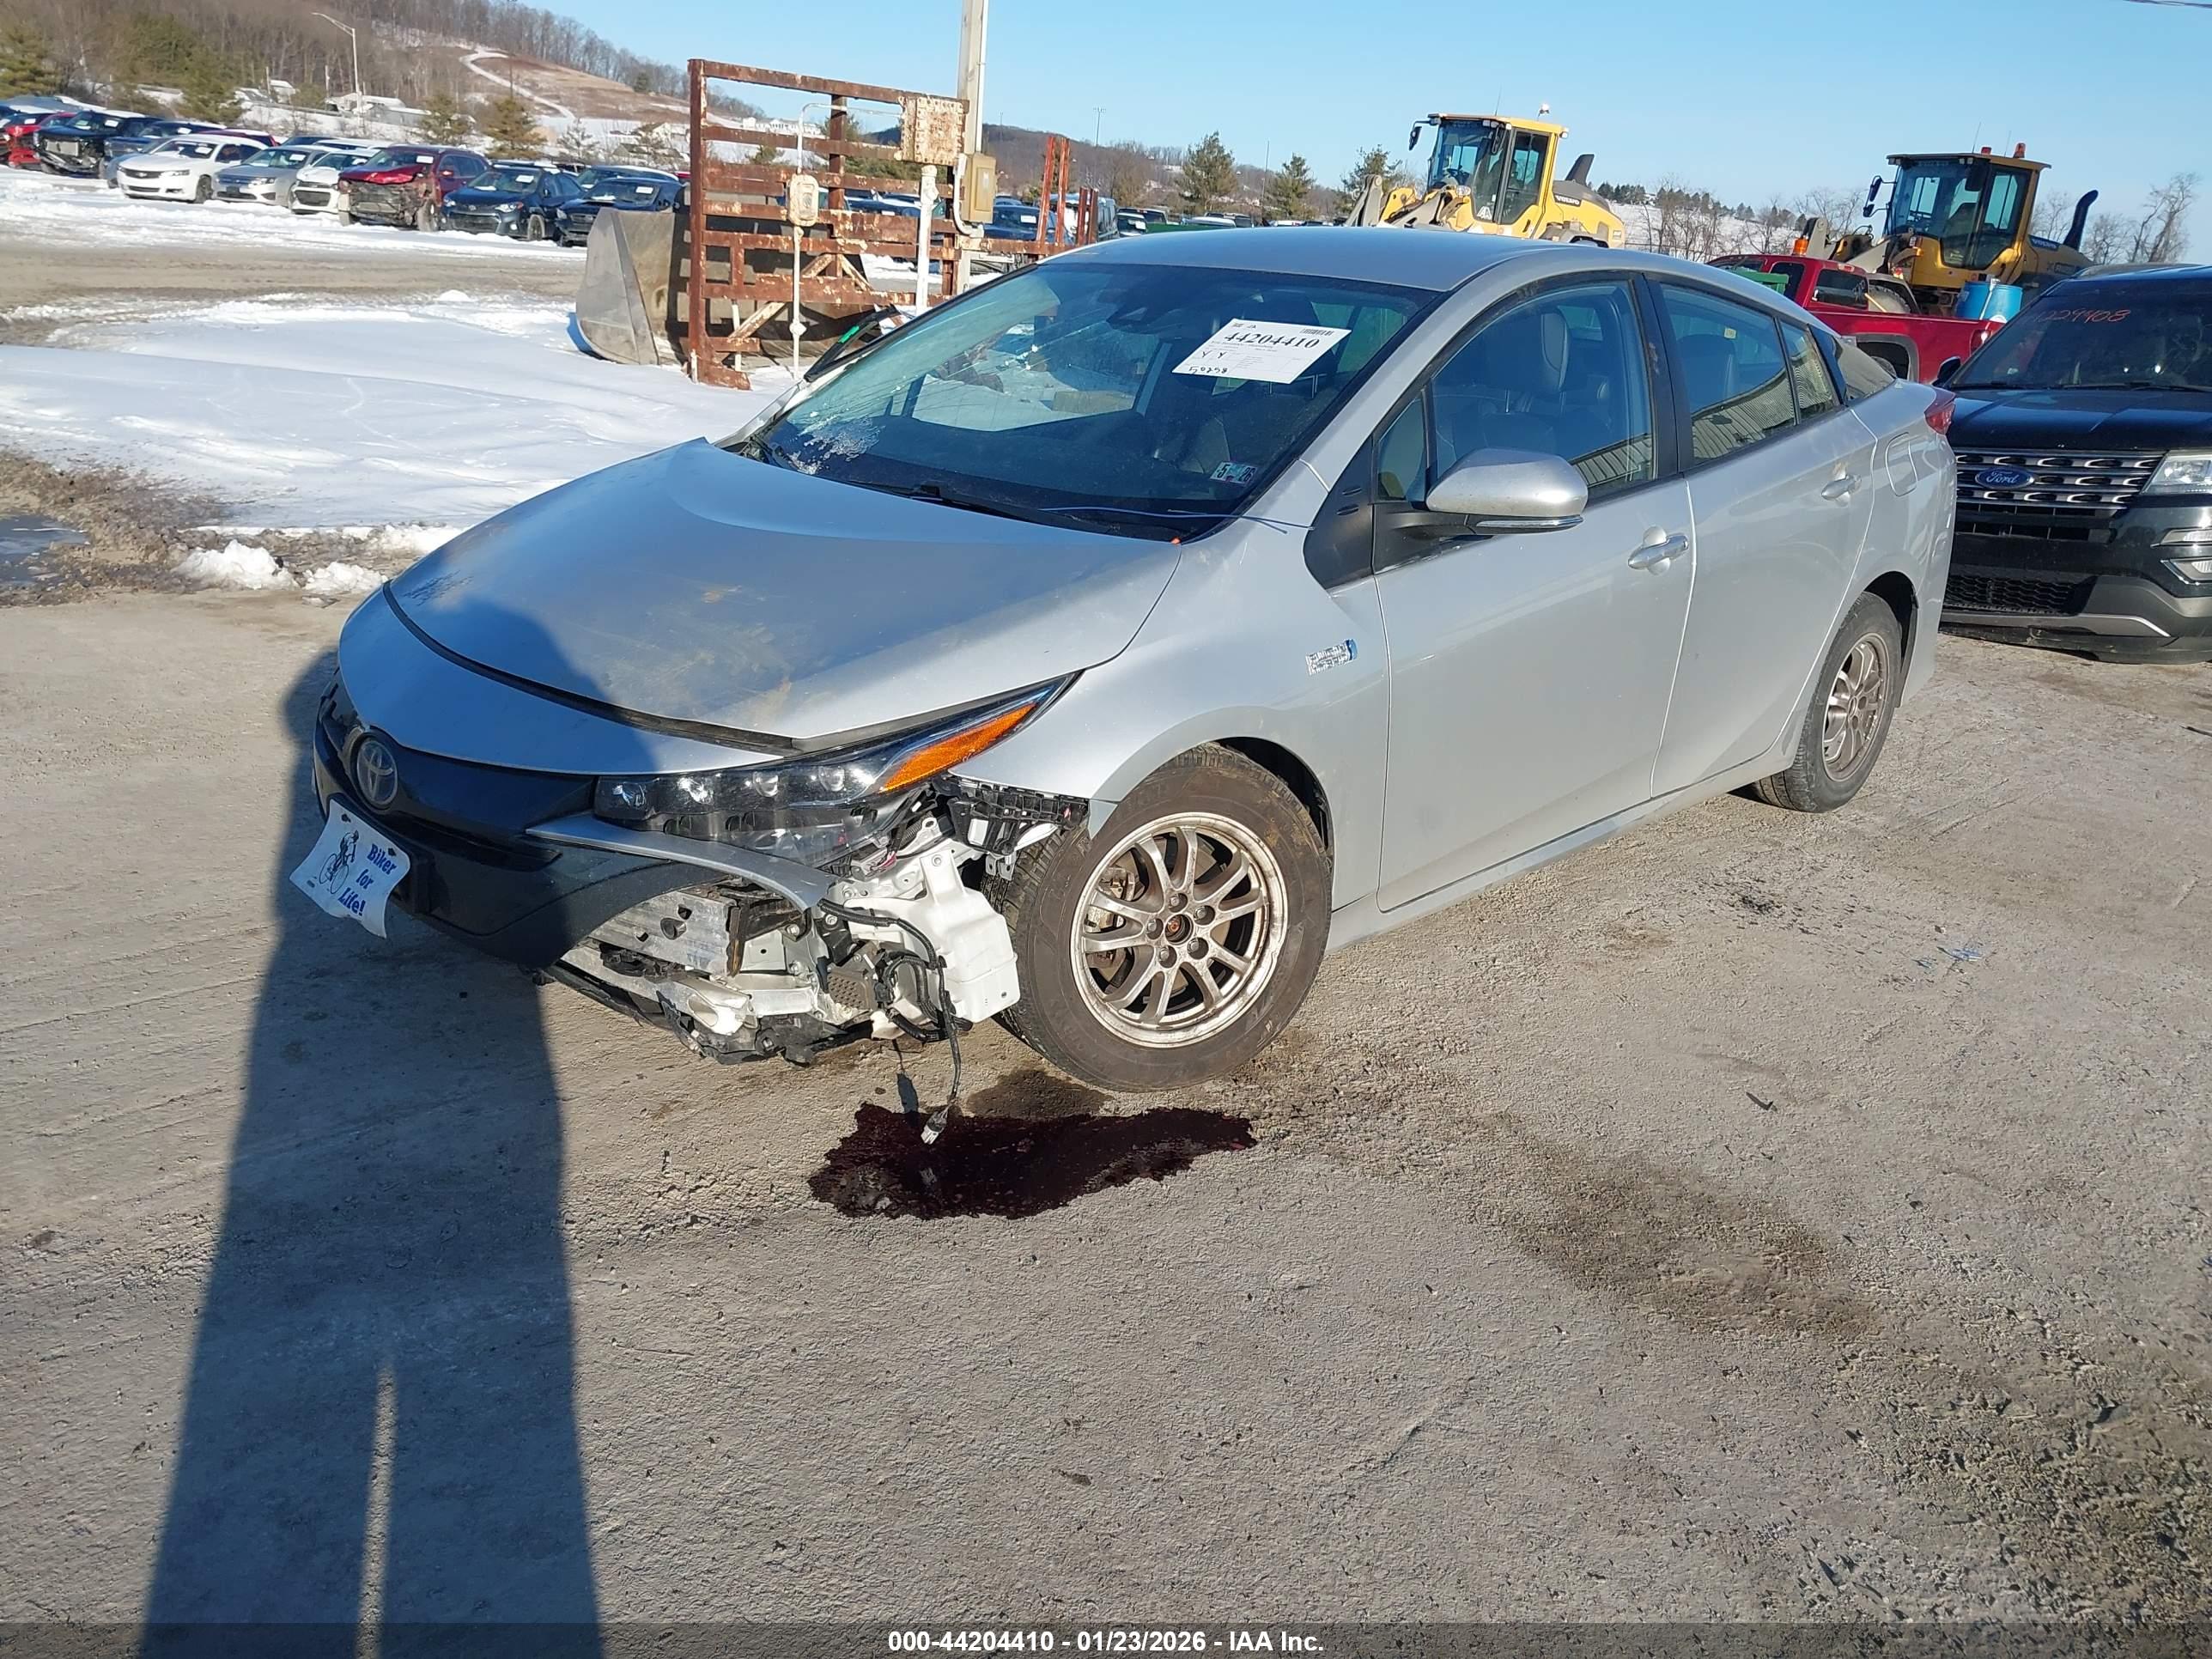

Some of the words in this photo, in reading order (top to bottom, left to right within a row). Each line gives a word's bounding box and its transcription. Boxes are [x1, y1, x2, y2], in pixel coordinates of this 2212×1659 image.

[1554, 195, 1580, 205] VOLVO
[1224, 331, 1321, 349] 44204410
[1237, 466, 1256, 483] 26
[1985, 471, 2020, 483] Ford
[367, 843, 398, 875] Biker
[356, 868, 374, 890] for
[337, 887, 367, 916] Life!
